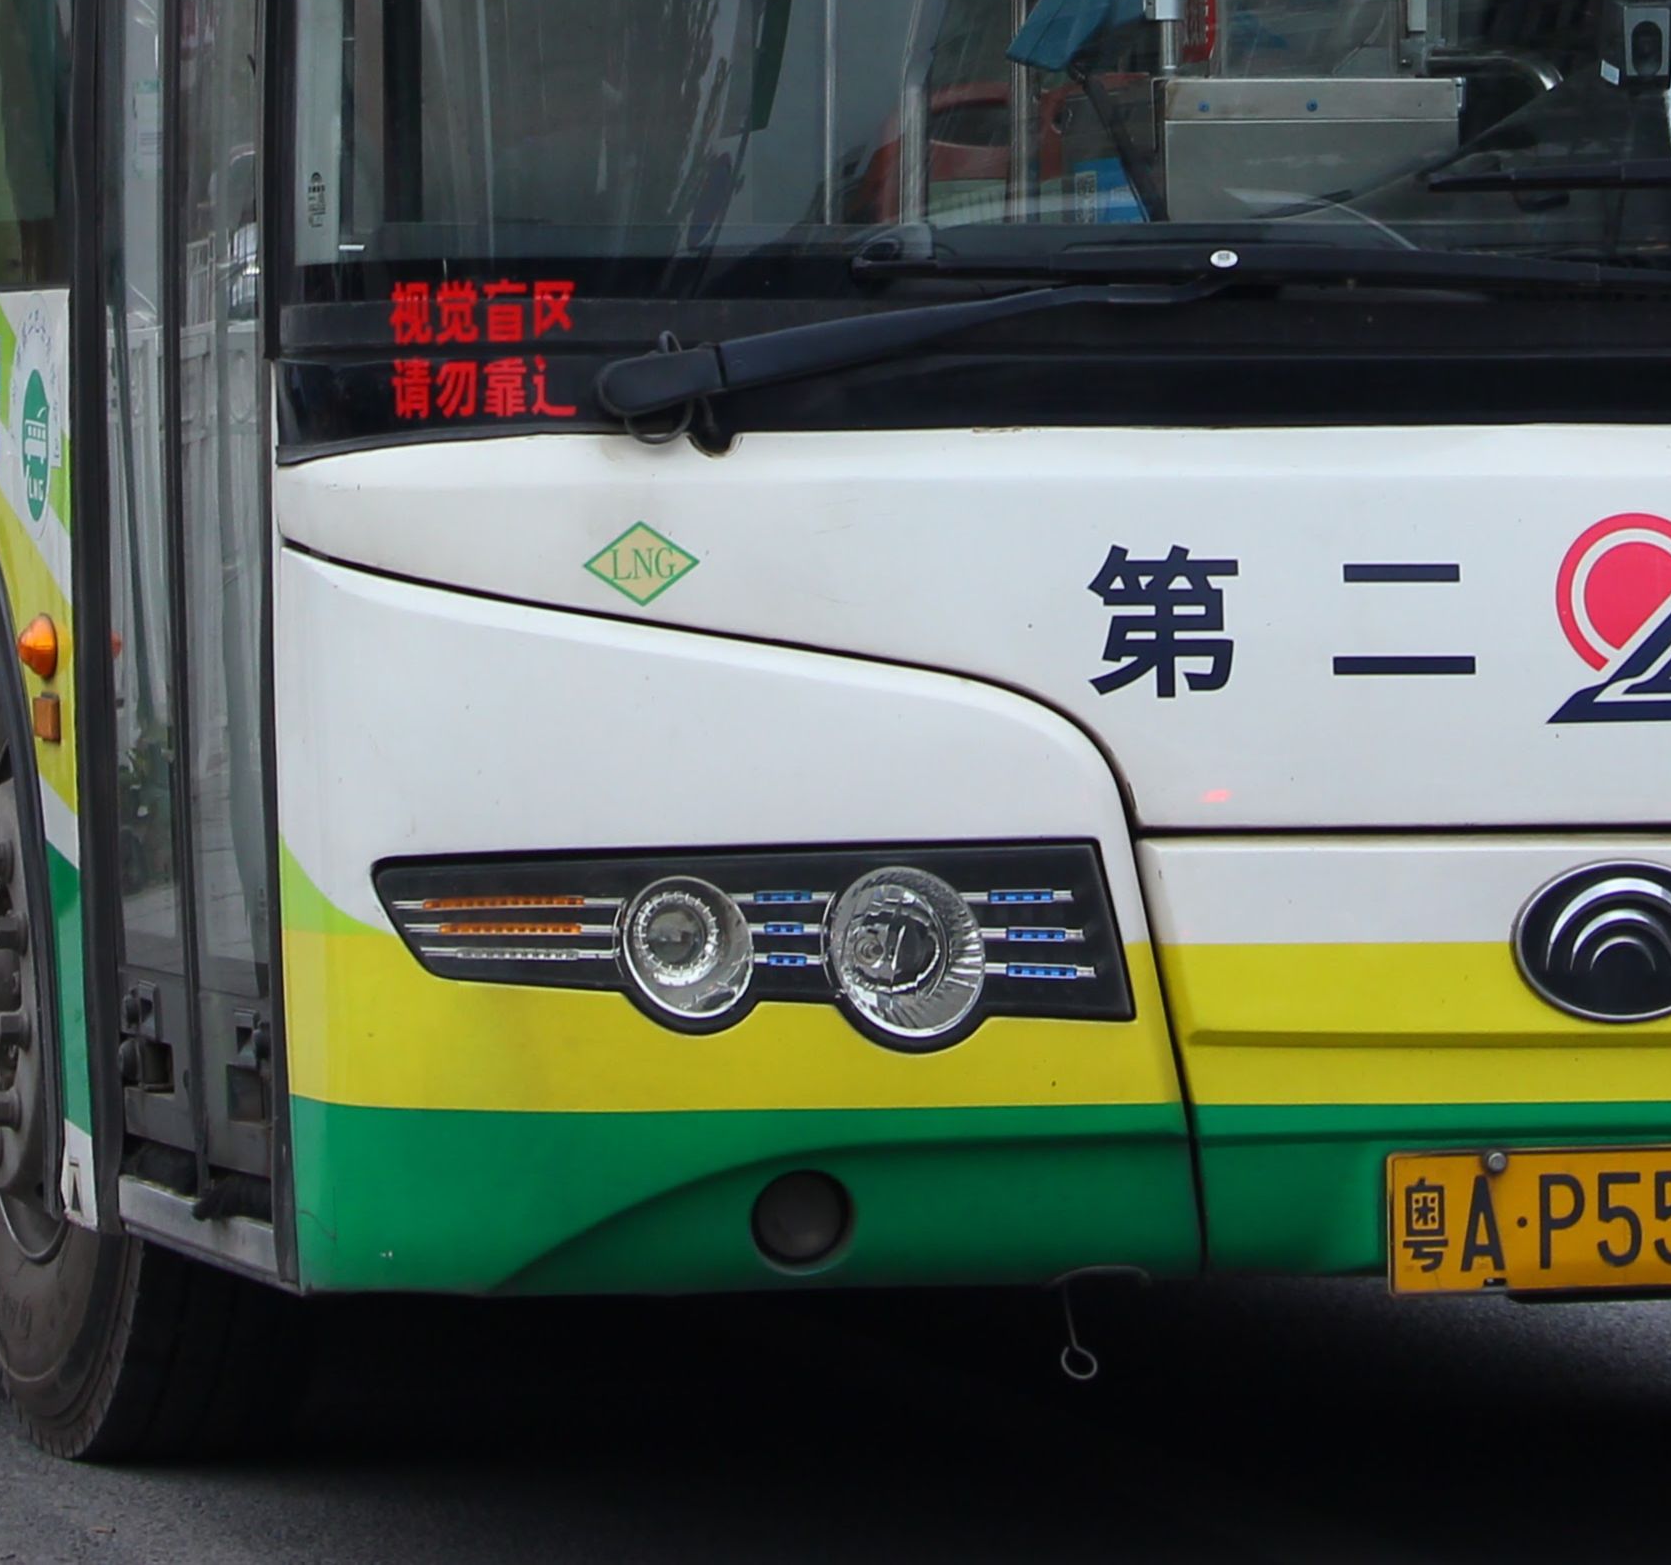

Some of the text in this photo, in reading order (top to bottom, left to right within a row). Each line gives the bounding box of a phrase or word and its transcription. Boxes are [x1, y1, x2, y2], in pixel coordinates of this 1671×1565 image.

[389, 279, 576, 345] 视觉盲区
[611, 547, 677, 581] LNG
